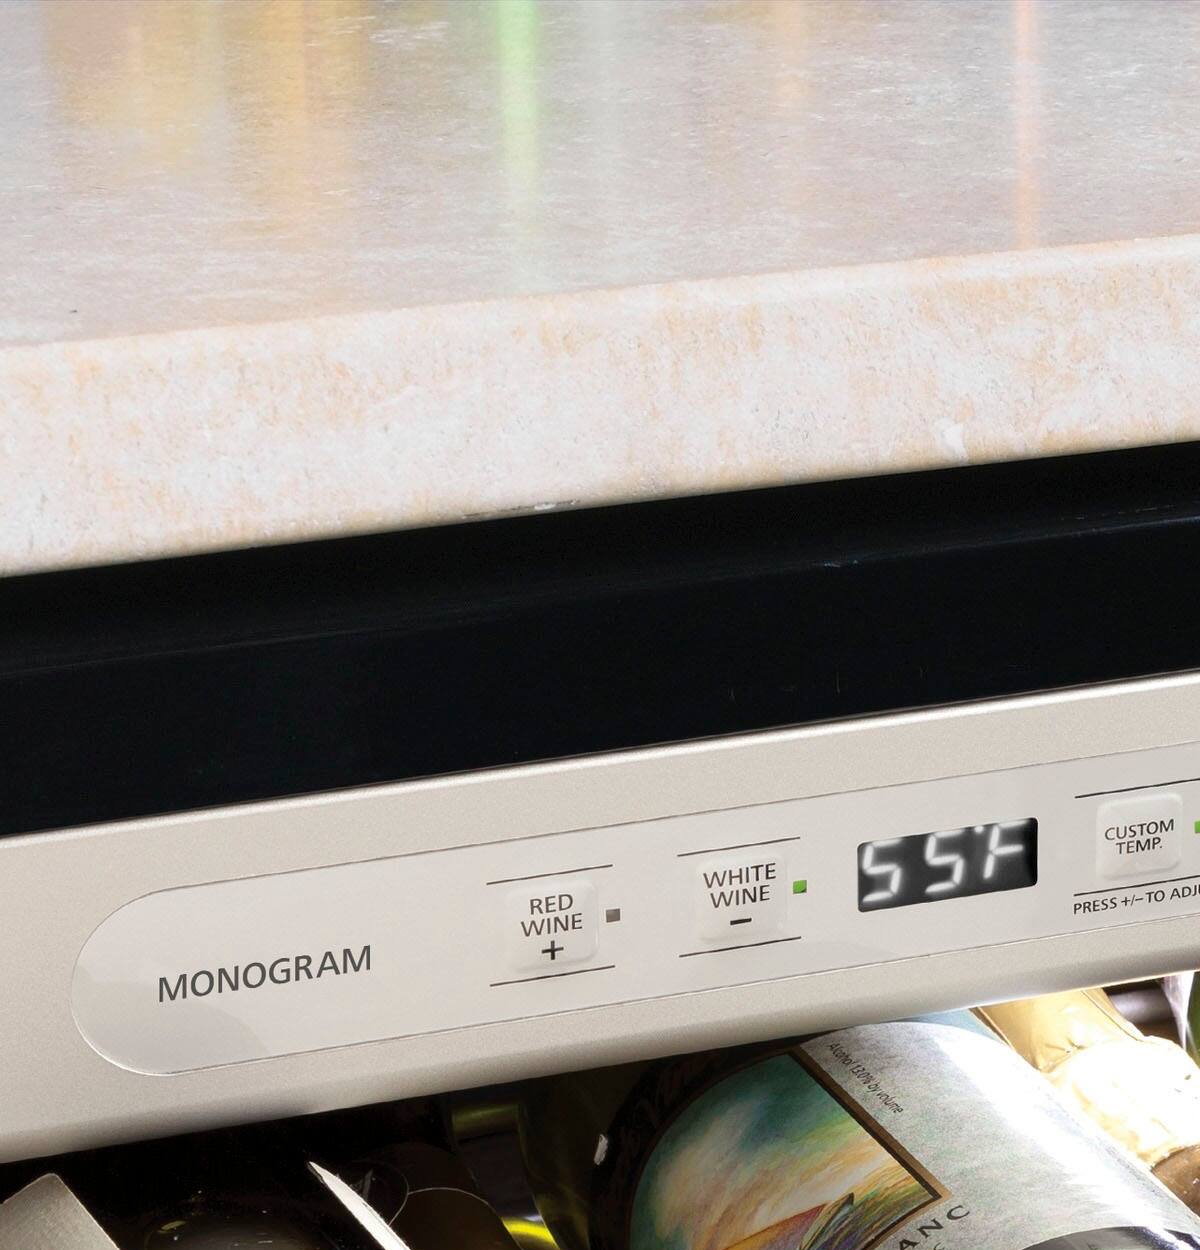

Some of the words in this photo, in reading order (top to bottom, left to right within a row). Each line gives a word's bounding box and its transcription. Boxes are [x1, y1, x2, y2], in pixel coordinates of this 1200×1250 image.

[1104, 818, 1175, 841] CUSTOM
[1116, 835, 1164, 855] TEMP.
[702, 862, 777, 889] WHITE
[529, 893, 574, 915] RED
[709, 884, 772, 909] WINE
[1073, 896, 1118, 915] PRESS
[1144, 889, 1166, 904] TO
[520, 912, 584, 937] WINE
[157, 945, 373, 1003] MONOGRAM
